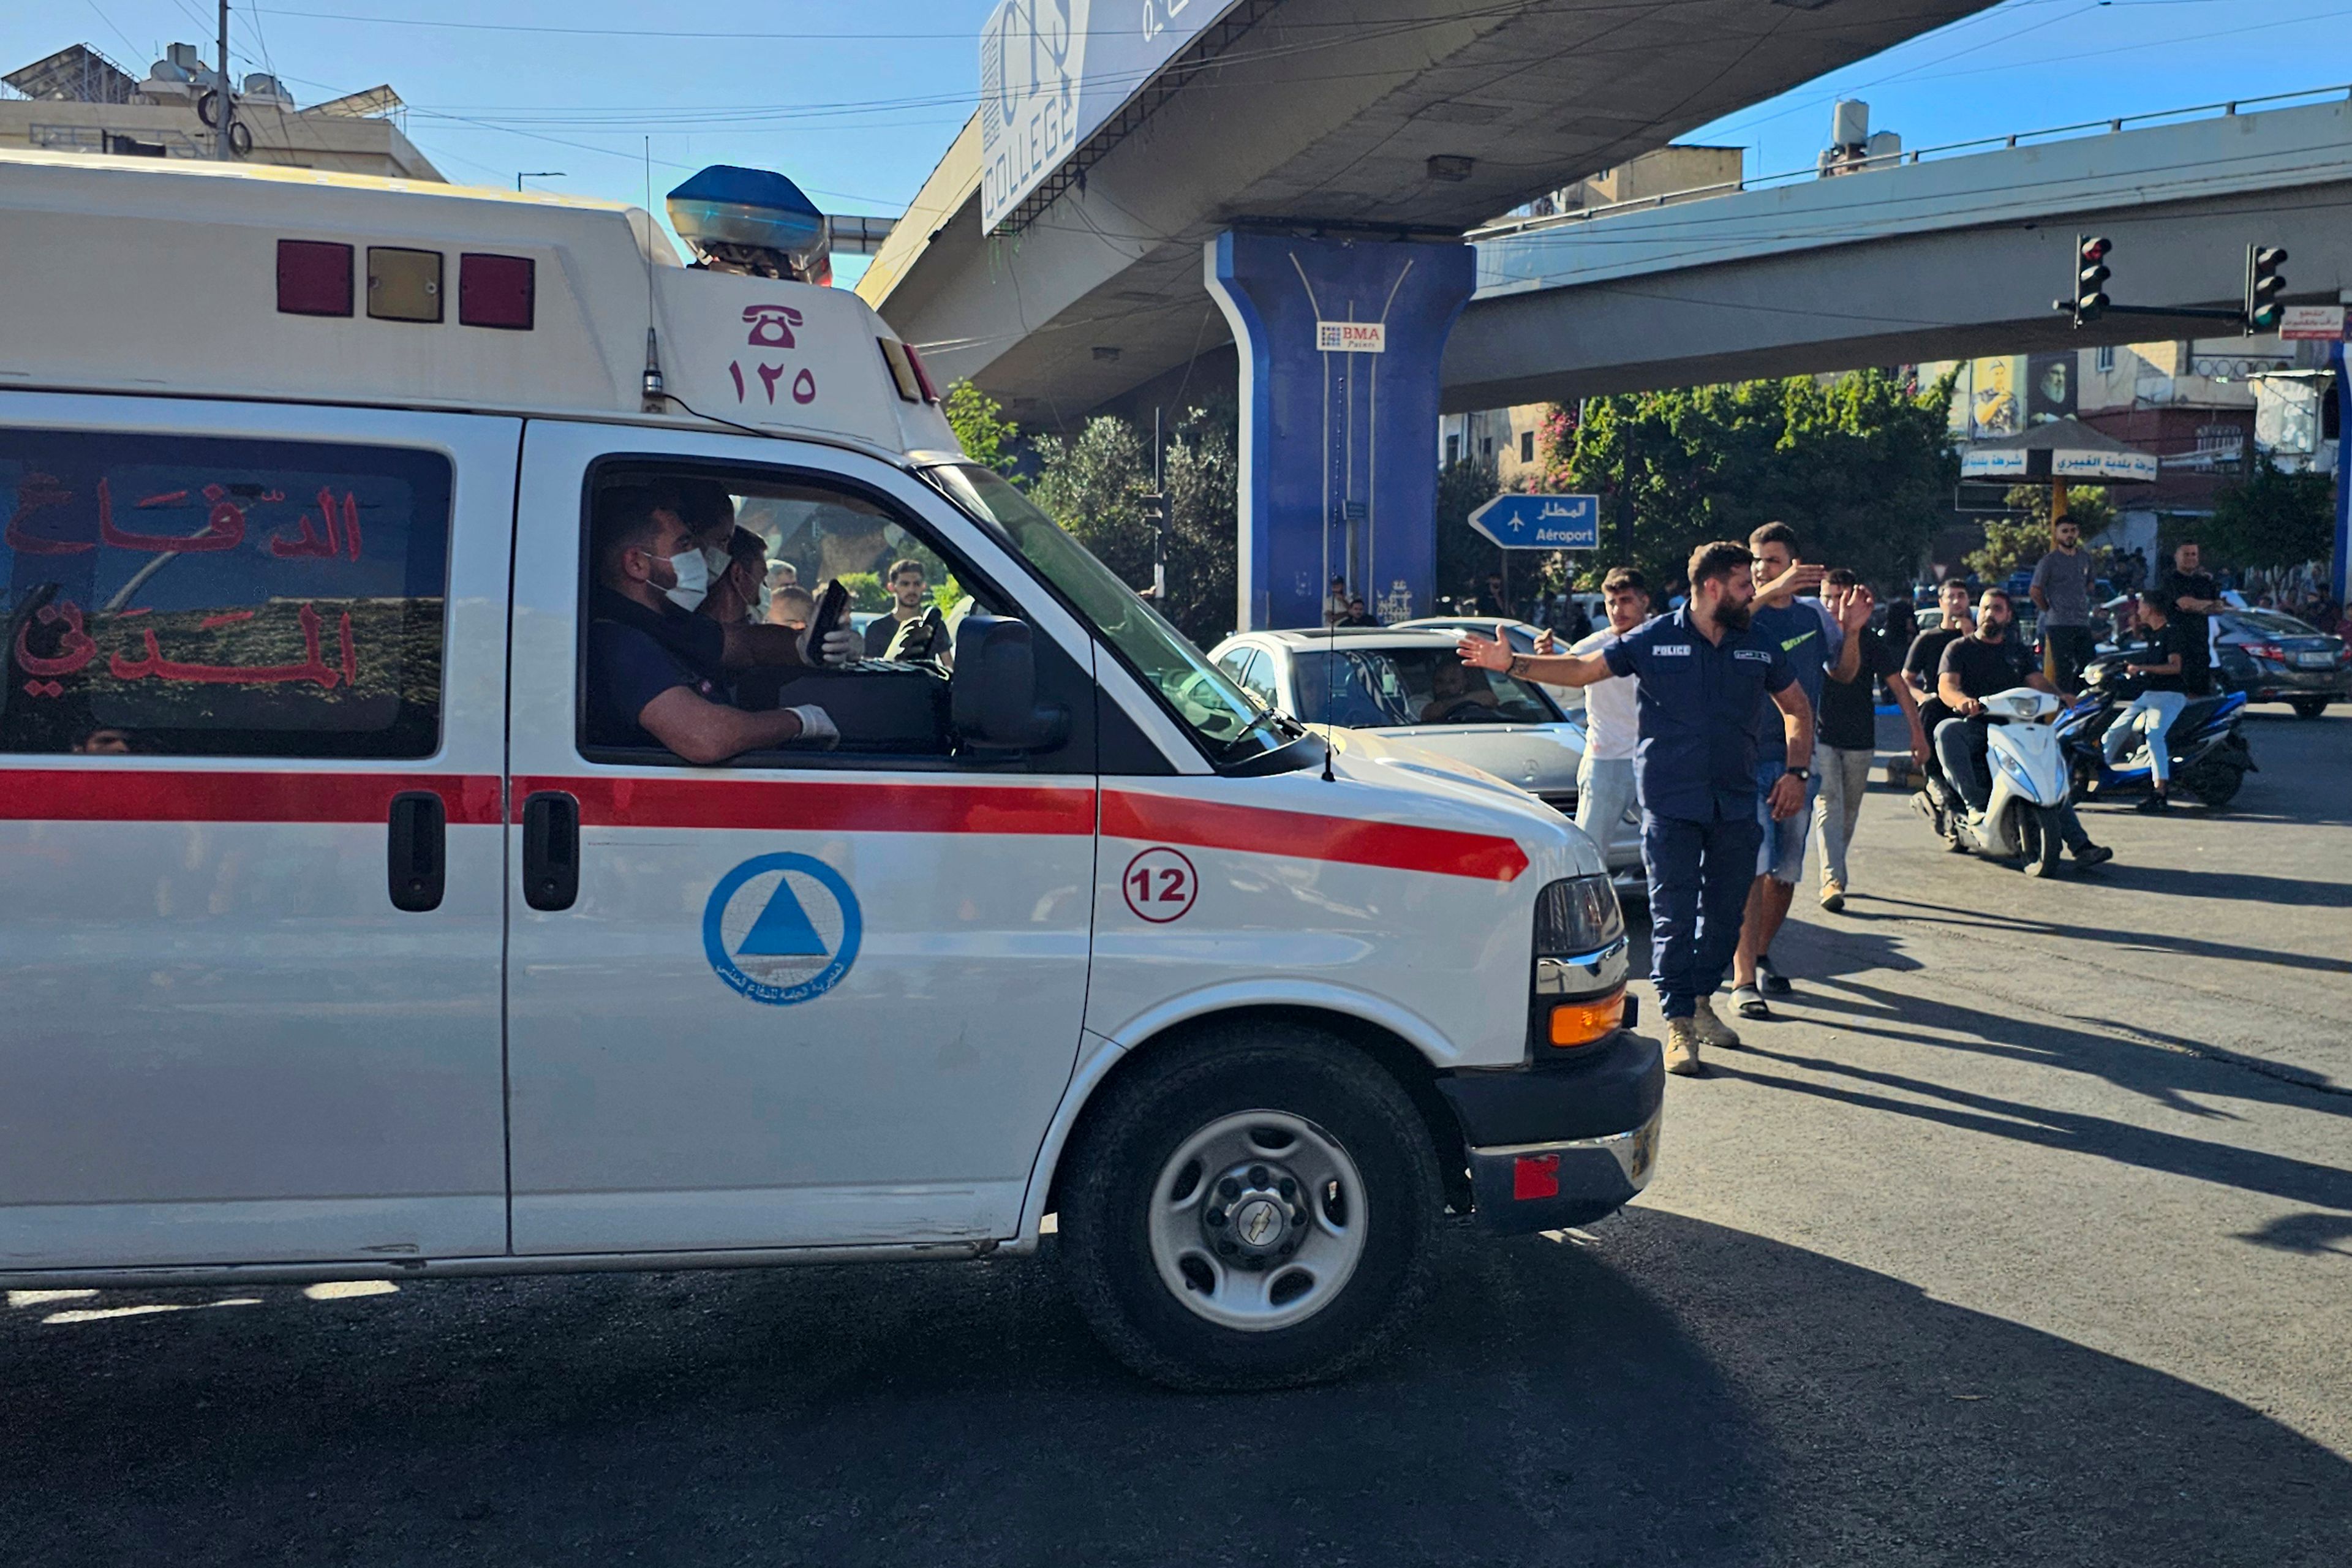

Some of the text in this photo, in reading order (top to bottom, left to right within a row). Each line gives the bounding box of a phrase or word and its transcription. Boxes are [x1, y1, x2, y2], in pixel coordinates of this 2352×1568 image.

[984, 85, 1074, 219] COLLEGE
[1343, 327, 1379, 340] BMA
[729, 360, 816, 405] ١٢٥
[1536, 502, 1586, 520] المطار
[1536, 528, 1593, 543] Aéroport
[1653, 646, 1691, 656] POLICE
[1130, 869, 1185, 902] 12
